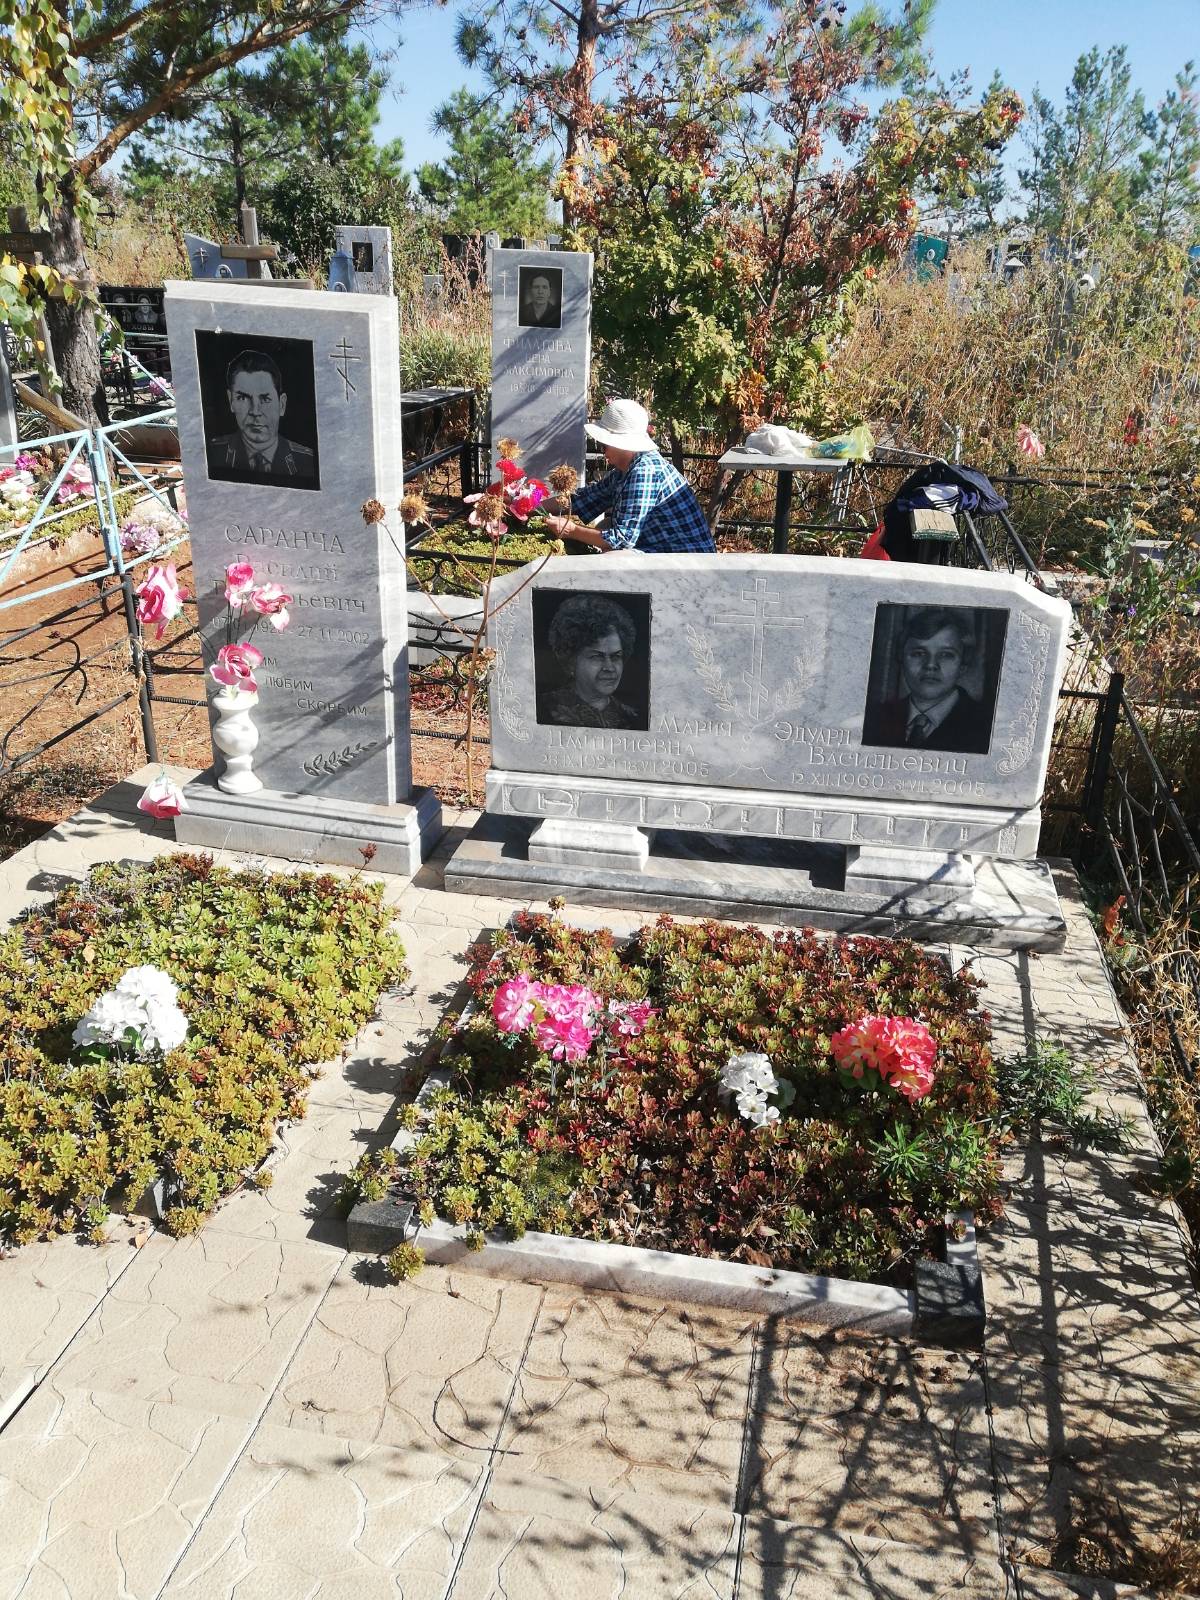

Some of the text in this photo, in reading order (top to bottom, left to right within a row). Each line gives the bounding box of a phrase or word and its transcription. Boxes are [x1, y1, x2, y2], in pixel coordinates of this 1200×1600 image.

[224, 524, 346, 554] САРАНЧА
[264, 676, 313, 691] ЛЮБИМ
[296, 698, 367, 717] СКОРБИМ
